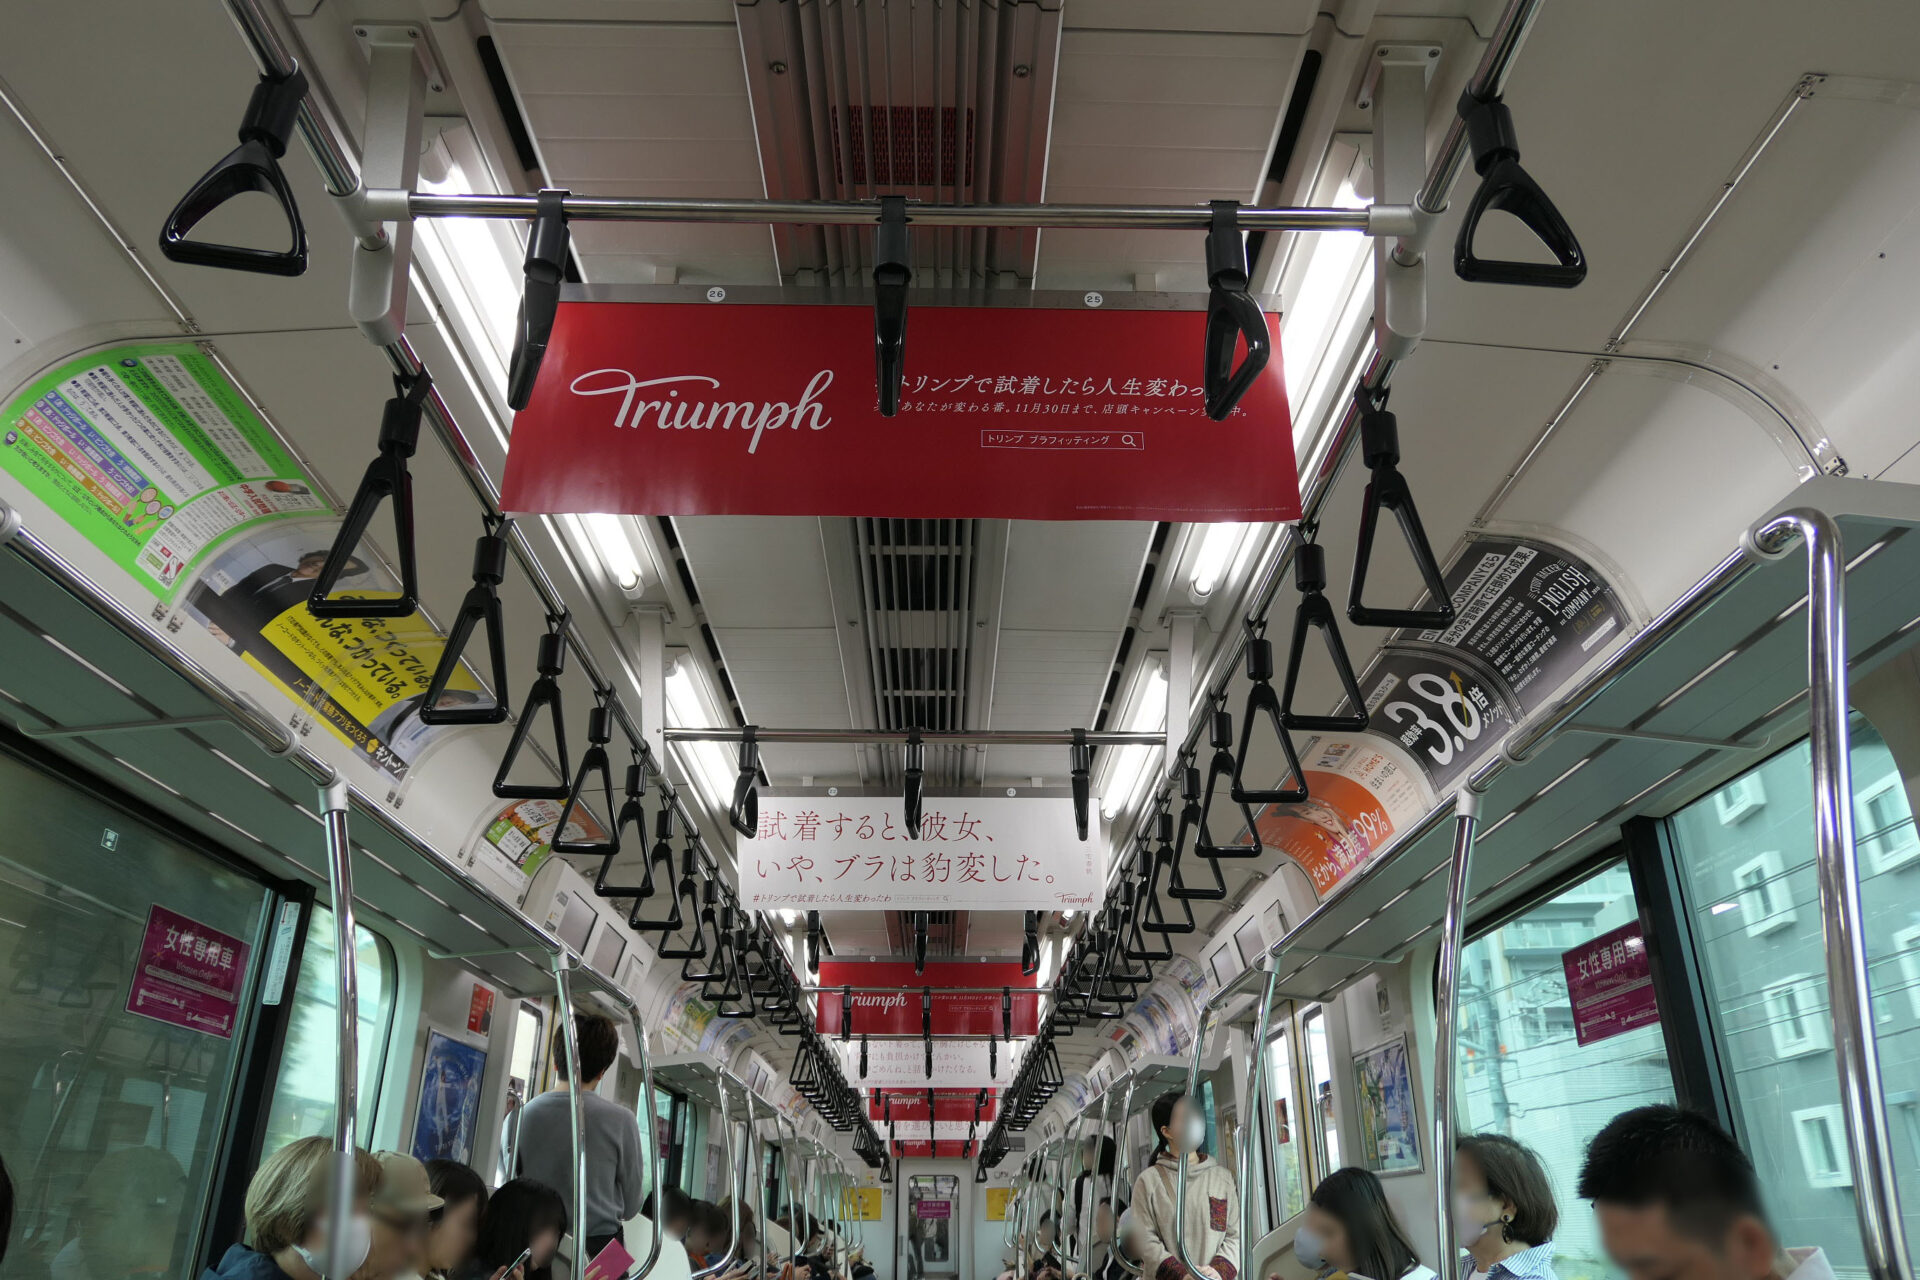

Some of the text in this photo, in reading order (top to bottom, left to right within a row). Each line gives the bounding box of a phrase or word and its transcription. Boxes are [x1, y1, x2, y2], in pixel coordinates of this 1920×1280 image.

[1086, 295, 1100, 303] 25
[874, 374, 1206, 397] トリンプで試着したら人生変わっ
[570, 368, 835, 454] Triumph
[988, 434, 1024, 443] トリンプ
[1537, 565, 1590, 615] ENGLISH
[1561, 588, 1593, 619] COMPANY
[757, 810, 994, 842] 試着すると、彼女、
[757, 852, 1056, 884] いや、ブラは豹変した。
[1054, 891, 1094, 907] Triumph
[163, 925, 235, 971] 女性専用車
[1577, 936, 1643, 980] 女性専用車
